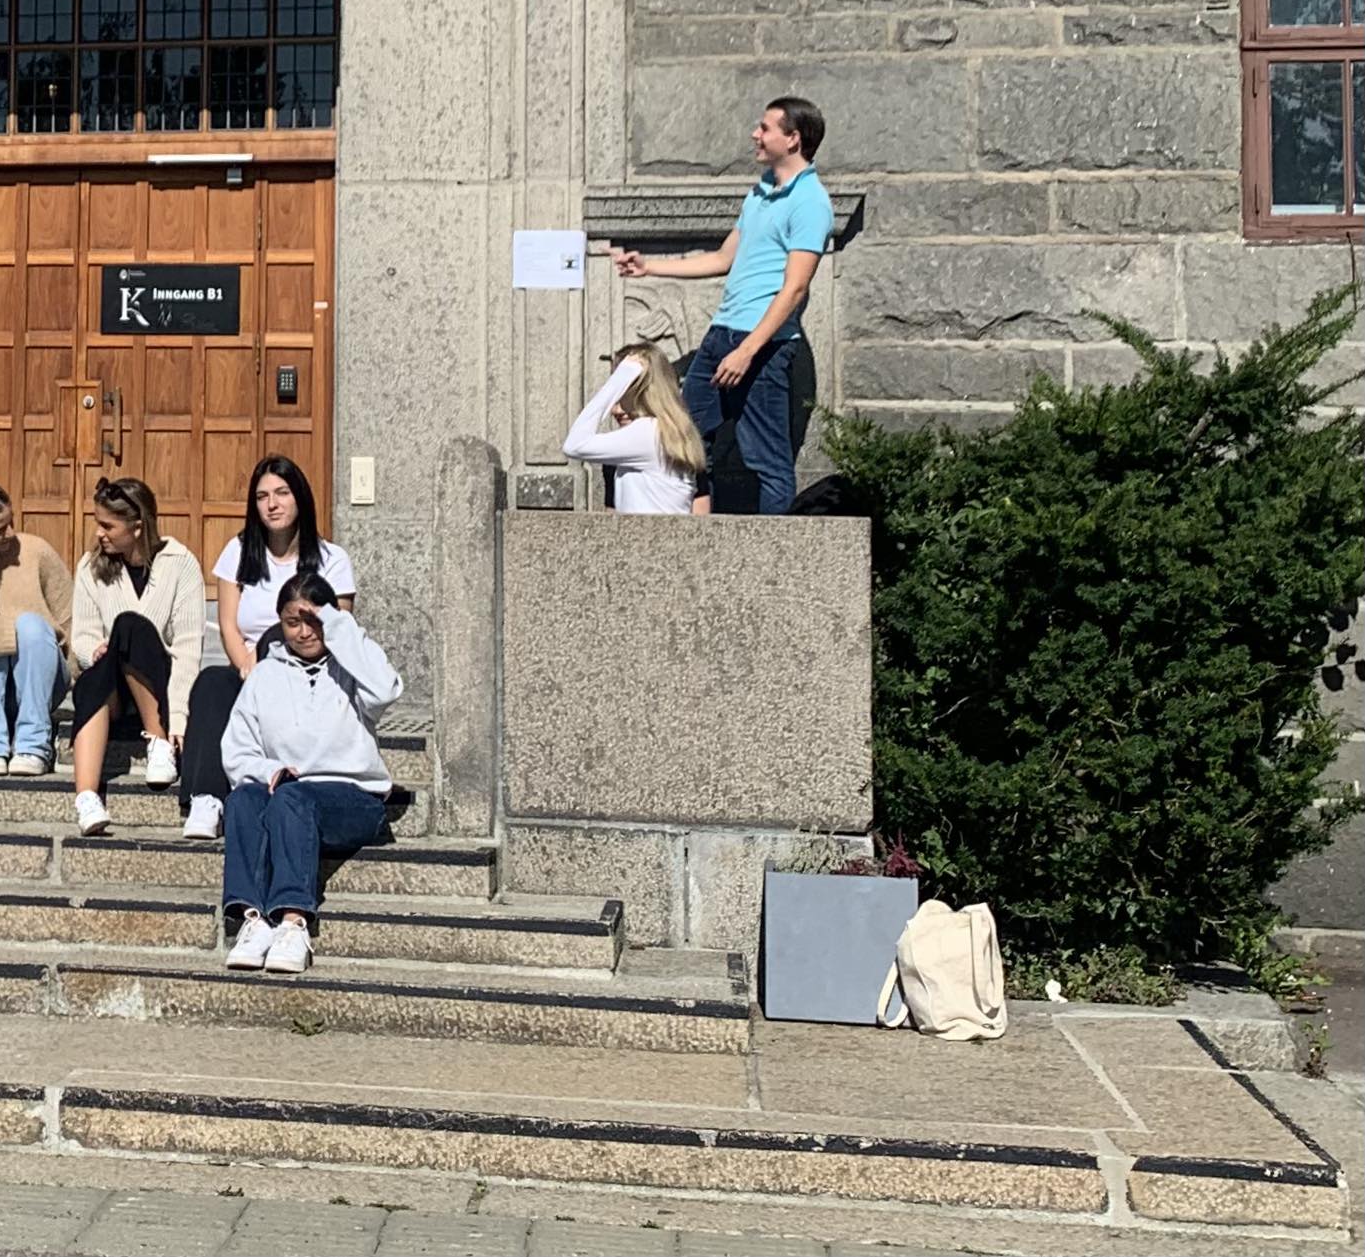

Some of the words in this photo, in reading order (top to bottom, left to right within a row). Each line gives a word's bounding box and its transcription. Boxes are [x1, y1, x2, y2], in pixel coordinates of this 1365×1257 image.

[119, 287, 150, 326] K
[152, 287, 204, 300] INNGANG
[207, 287, 223, 300] B1
